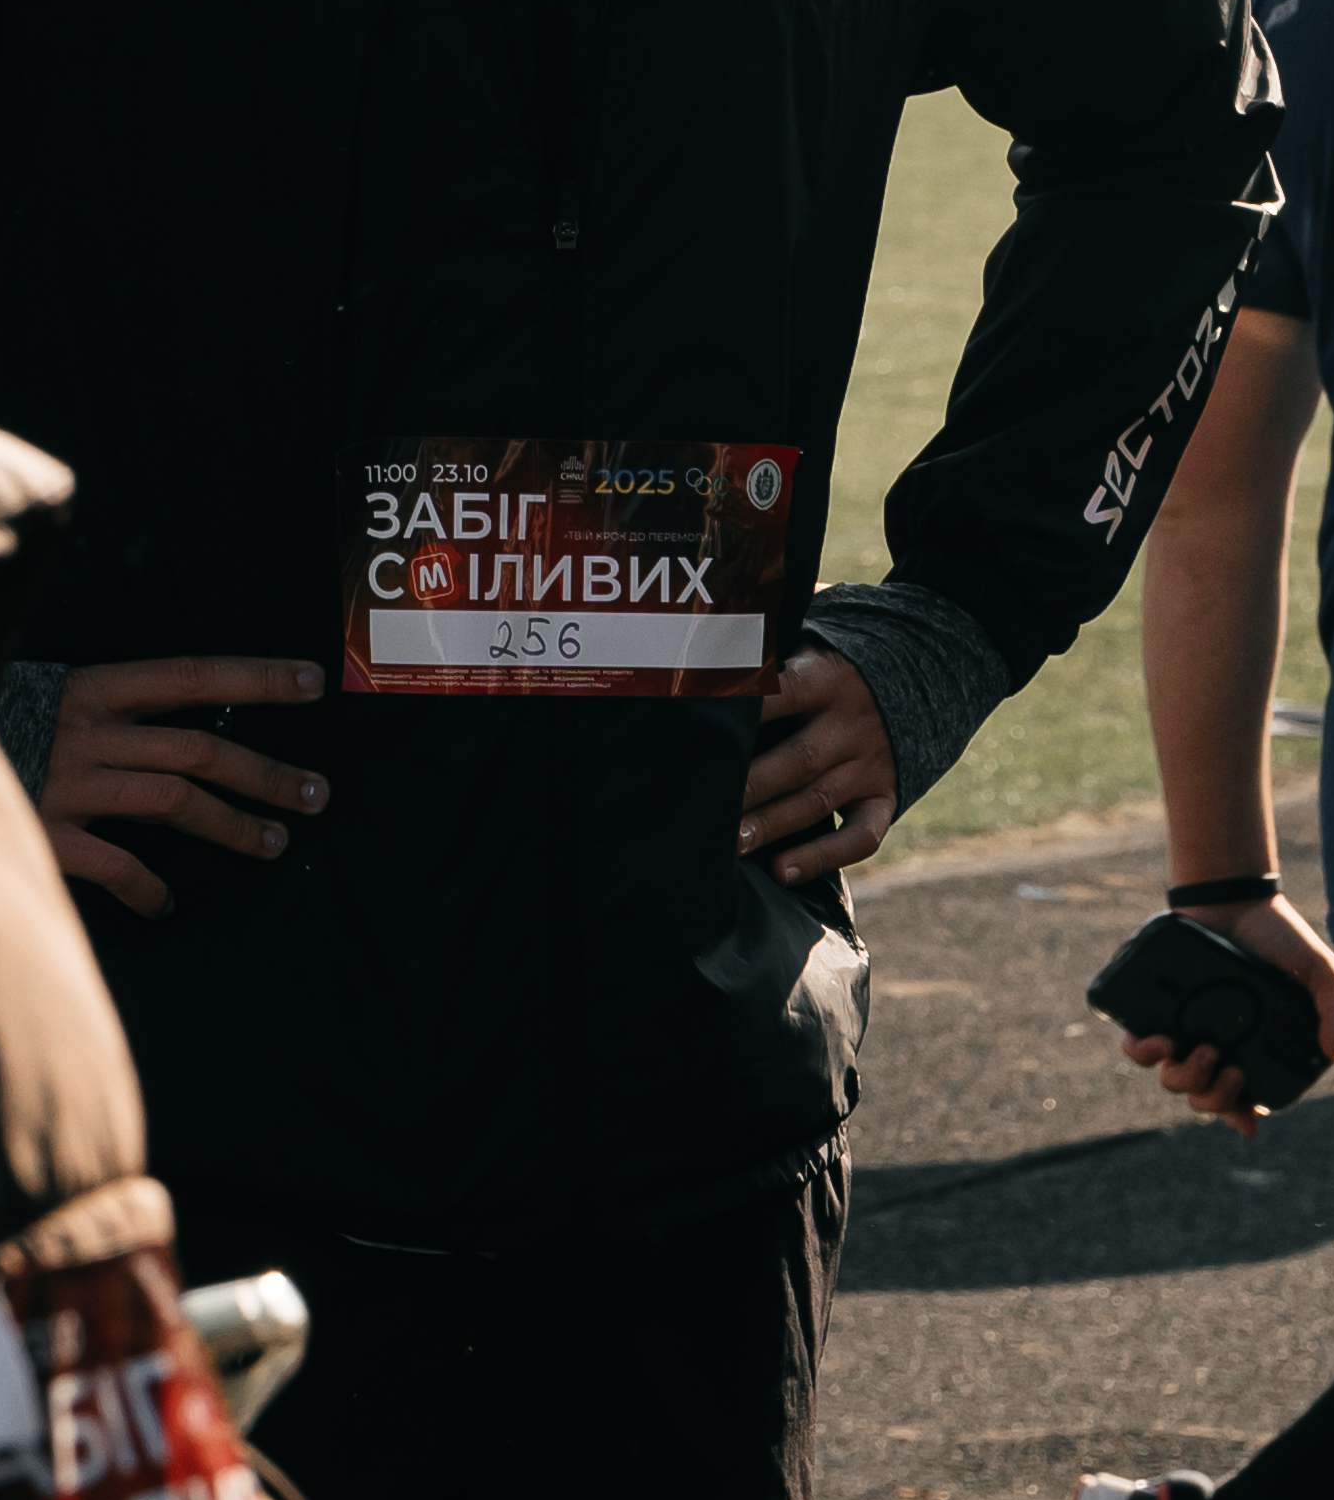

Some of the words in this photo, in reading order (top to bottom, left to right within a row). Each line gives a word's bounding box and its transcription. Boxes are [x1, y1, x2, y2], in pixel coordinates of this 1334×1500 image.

[1083, 306, 1223, 546] SECTOR
[364, 464, 417, 483] 11:00
[432, 464, 488, 483] 23.10
[595, 468, 676, 495] 2025
[365, 491, 547, 541] ЗАБІГ
[629, 532, 646, 542] ДО
[488, 617, 581, 660] 256
